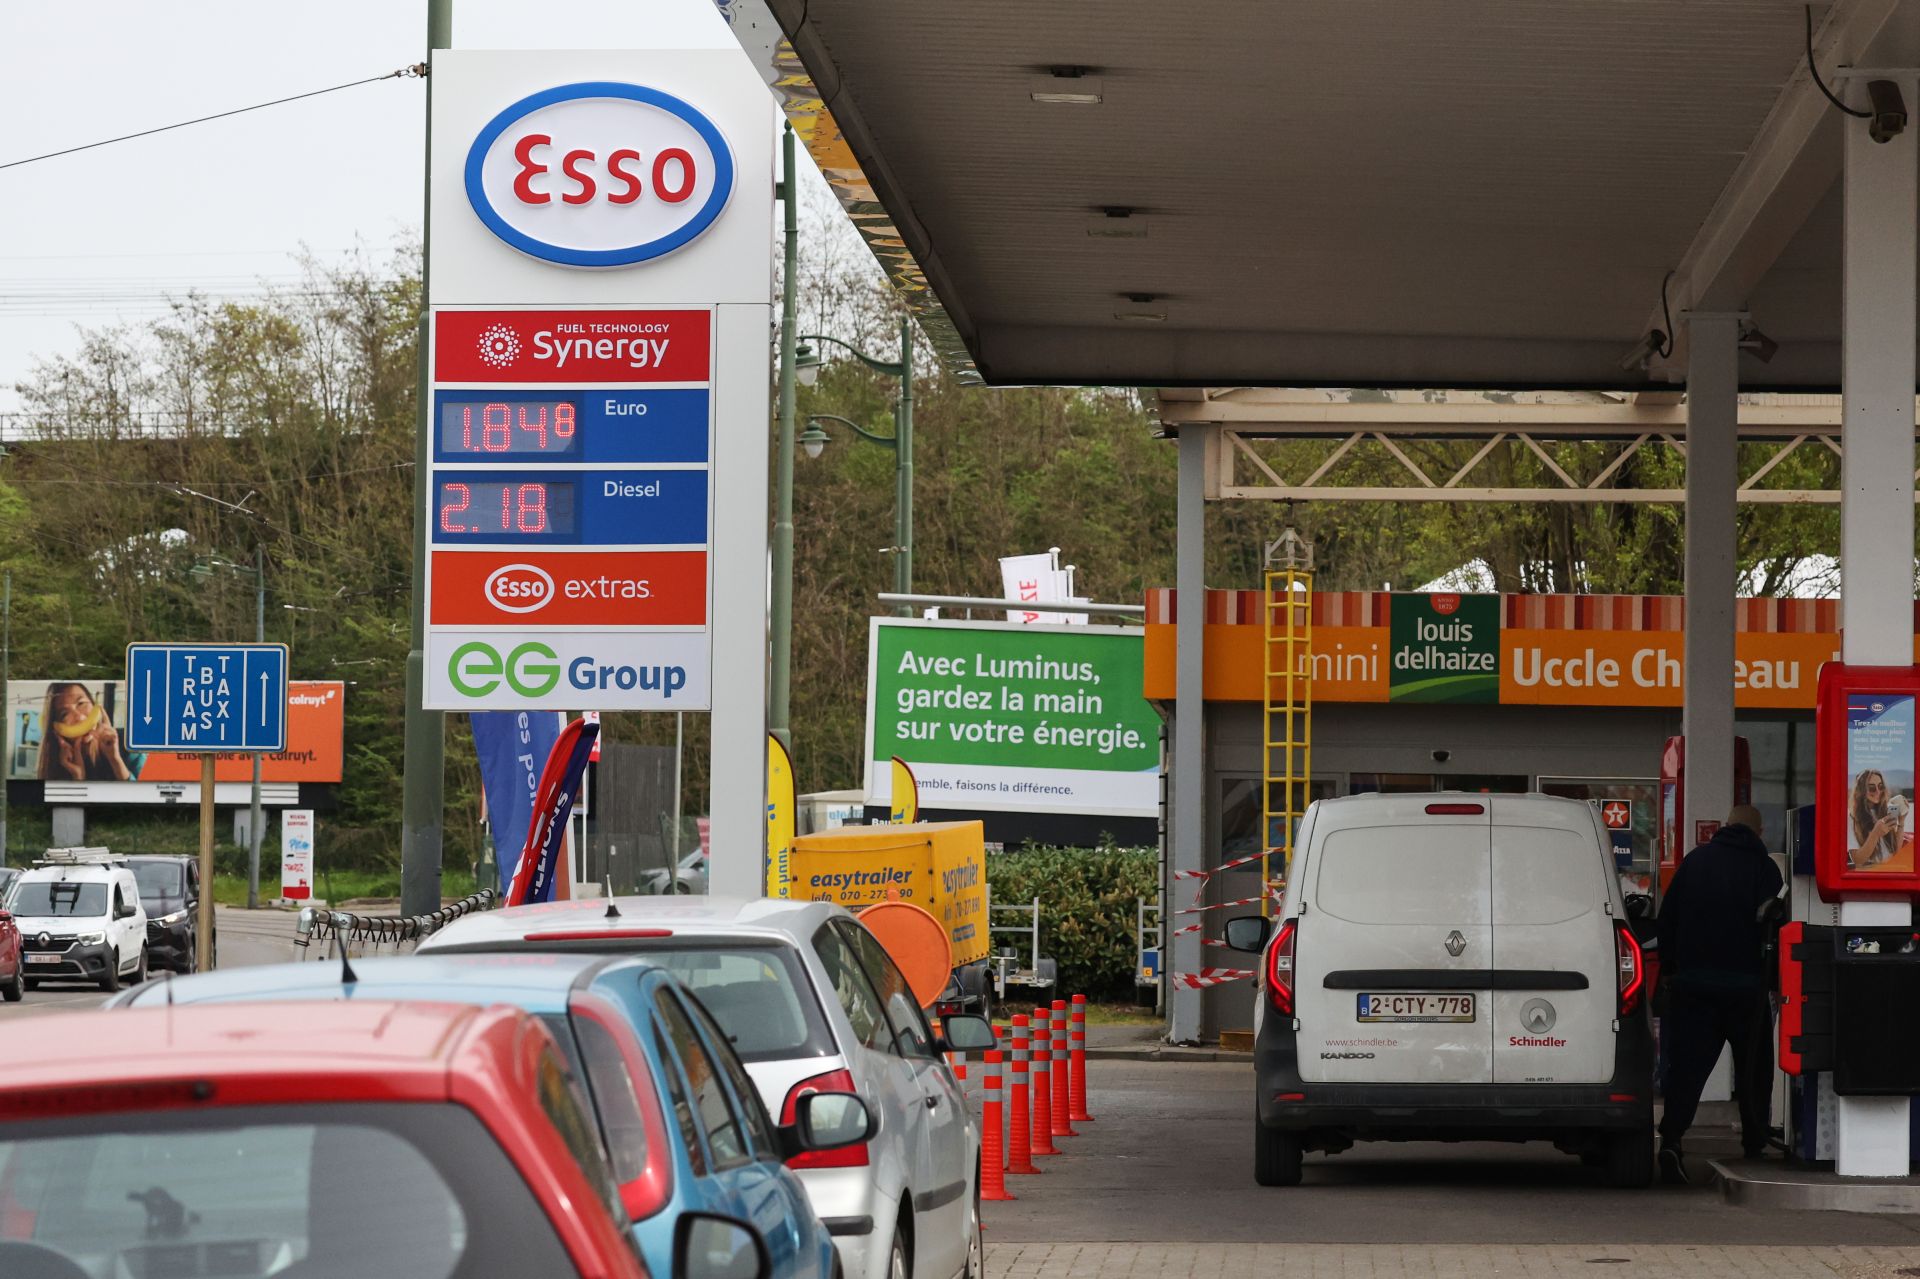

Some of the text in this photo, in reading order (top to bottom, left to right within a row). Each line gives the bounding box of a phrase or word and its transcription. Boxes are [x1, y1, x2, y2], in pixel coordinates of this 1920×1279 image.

[513, 134, 696, 204] Esso
[557, 324, 670, 333] FUEL TECHNOLOGY
[533, 331, 670, 368] Synergy
[604, 400, 647, 415] Euro
[463, 403, 575, 452] 1.848
[603, 480, 660, 497] Diesel
[496, 575, 650, 598] Esso extras
[1417, 617, 1473, 642] louis
[898, 651, 1100, 685] Avec Luminus,
[1299, 643, 1378, 681] mini
[1394, 645, 1495, 671] delhaize
[1513, 647, 1620, 687] Uccle
[1632, 648, 1800, 688] Cheau
[568, 656, 686, 698] Group
[181, 656, 197, 741] TRAM
[200, 667, 213, 729] BUS
[216, 656, 230, 741] TAXI
[897, 684, 1102, 714] gardez la main
[896, 720, 1146, 753] sur votre énergie.
[916, 779, 1074, 795] emble, faisons la différence.
[811, 867, 912, 890] easytrailer
[840, 891, 861, 900] 070
[1361, 1007, 1368, 1015] B
[1370, 997, 1471, 1014] 2-CTY-778
[1325, 1038, 1398, 1047] www.schindler.be
[1509, 1036, 1567, 1047] Schindler
